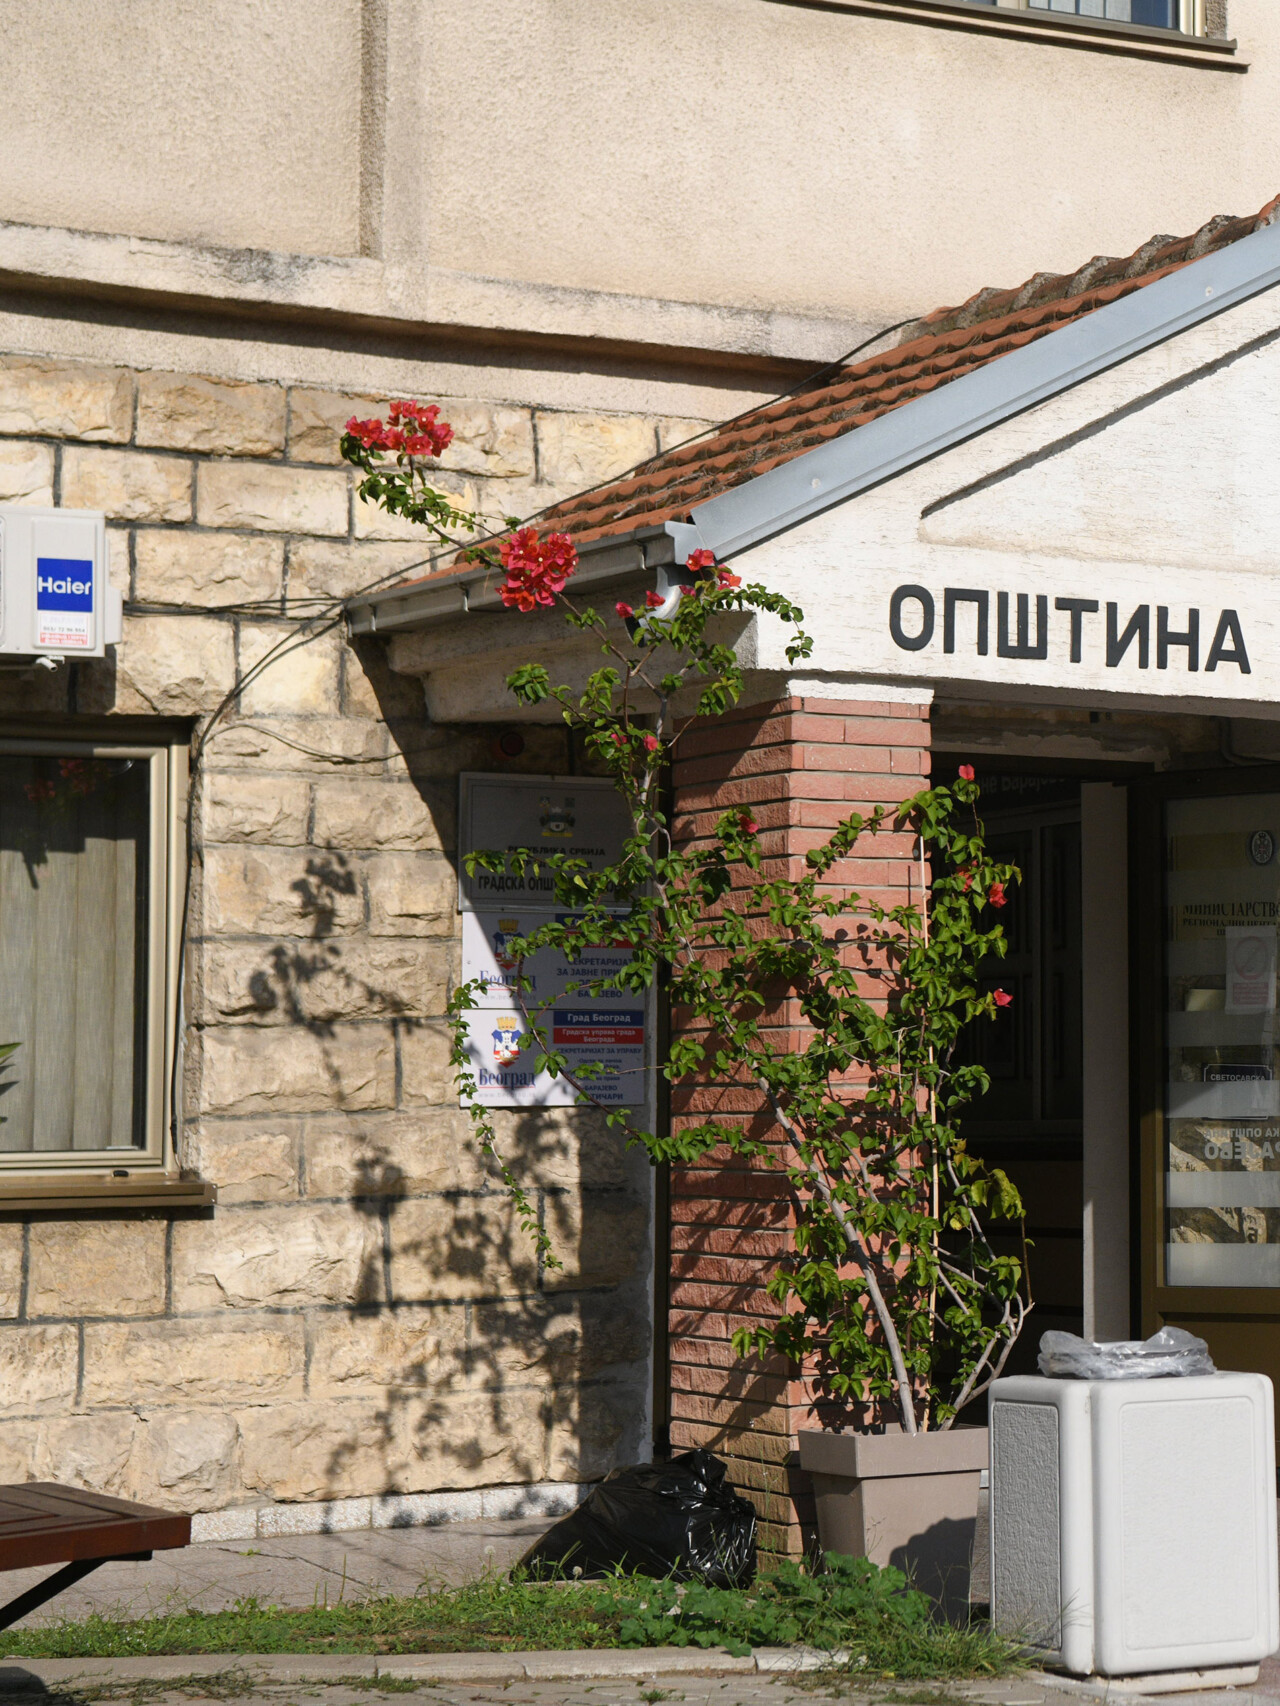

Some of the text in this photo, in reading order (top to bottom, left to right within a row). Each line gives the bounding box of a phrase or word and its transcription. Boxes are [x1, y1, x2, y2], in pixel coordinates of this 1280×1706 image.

[38, 576, 91, 595] Haier
[889, 584, 1252, 674] ОПШТИНА
[569, 847, 606, 856] СРБИЈА
[478, 875, 525, 892] ГРАДСКА
[556, 968, 569, 976] ЗА
[570, 968, 599, 977] ЈАВНЕ
[577, 990, 623, 998] БАЈЕВО
[567, 1013, 631, 1023] Град Београд
[479, 1068, 536, 1090] Београд
[1210, 1073, 1266, 1082] СВЕТОСАВСКА
